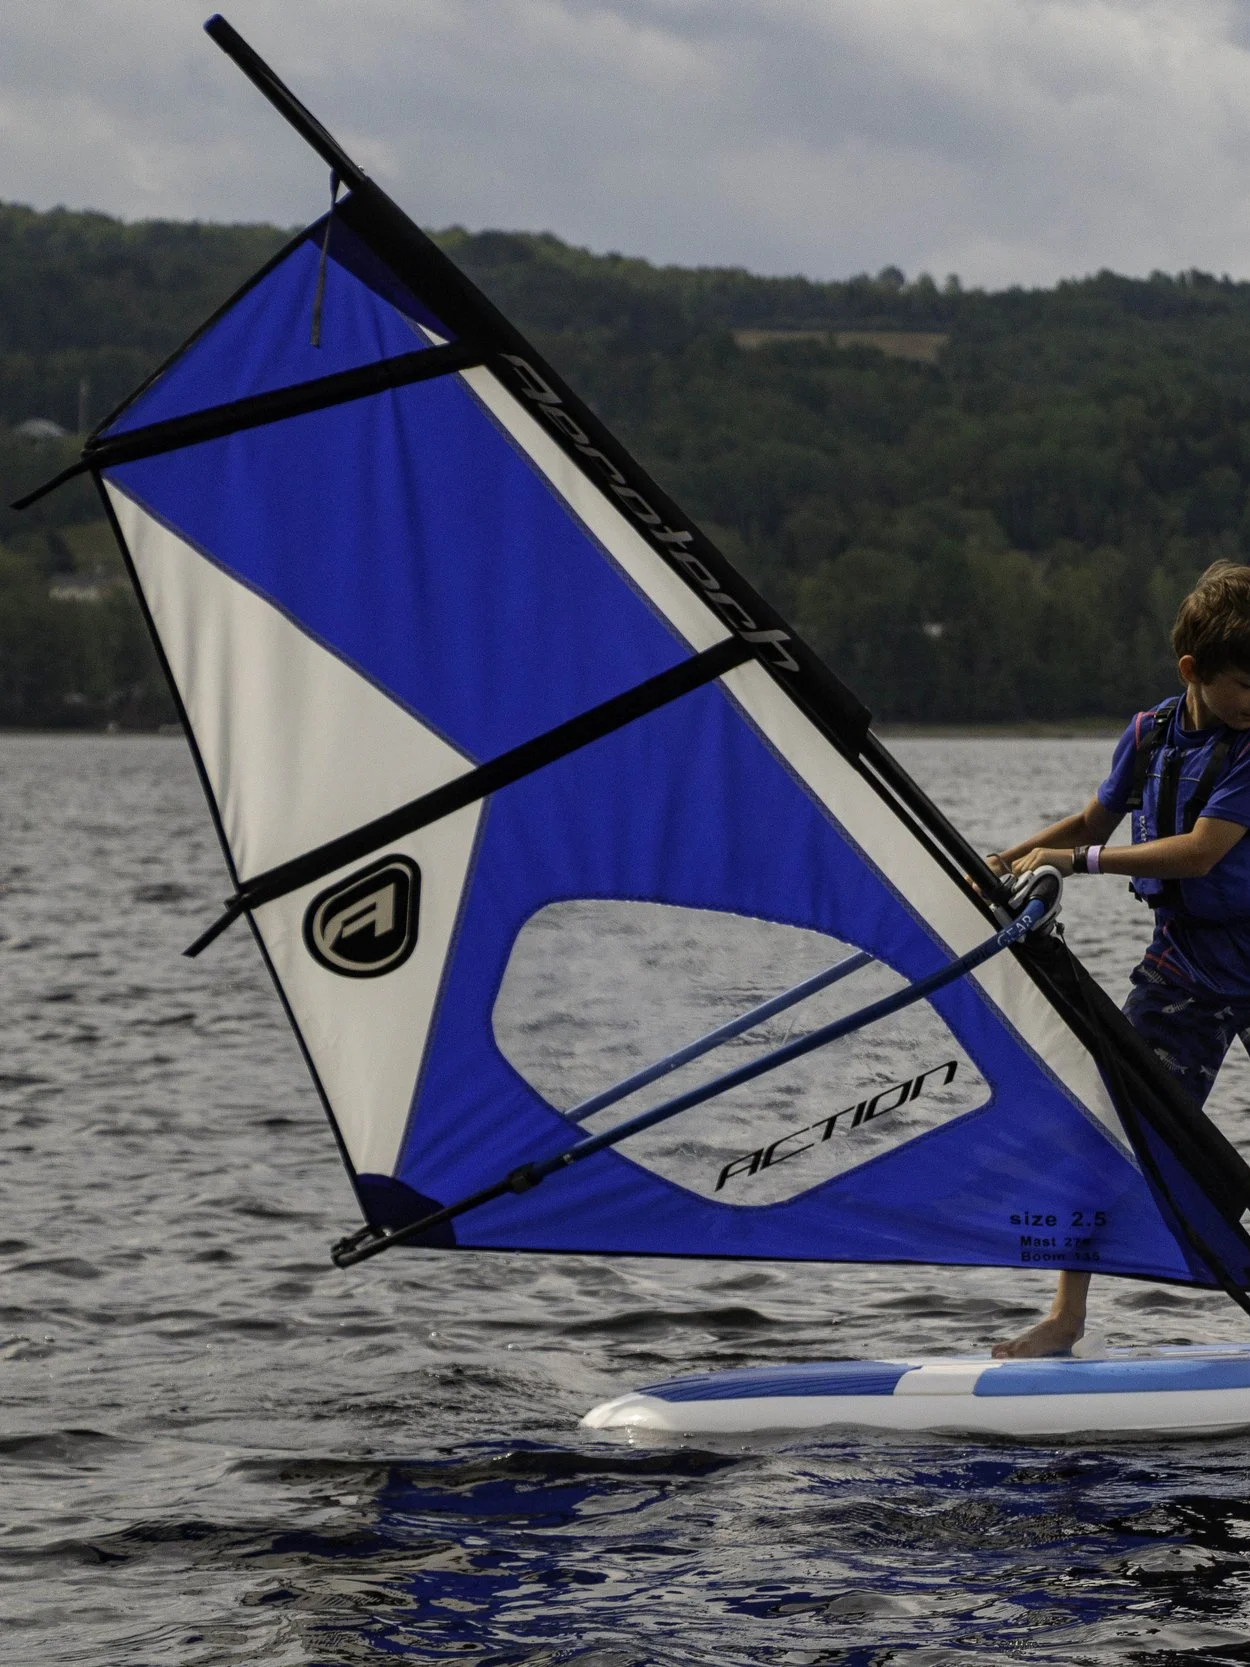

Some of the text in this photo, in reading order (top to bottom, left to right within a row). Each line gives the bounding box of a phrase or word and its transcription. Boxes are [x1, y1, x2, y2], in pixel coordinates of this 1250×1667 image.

[714, 1060, 958, 1192] ACTION
[1009, 1211, 1107, 1227] size 2.5
[1020, 1236, 1057, 1247] Mast
[1021, 1251, 1066, 1262] Boom
